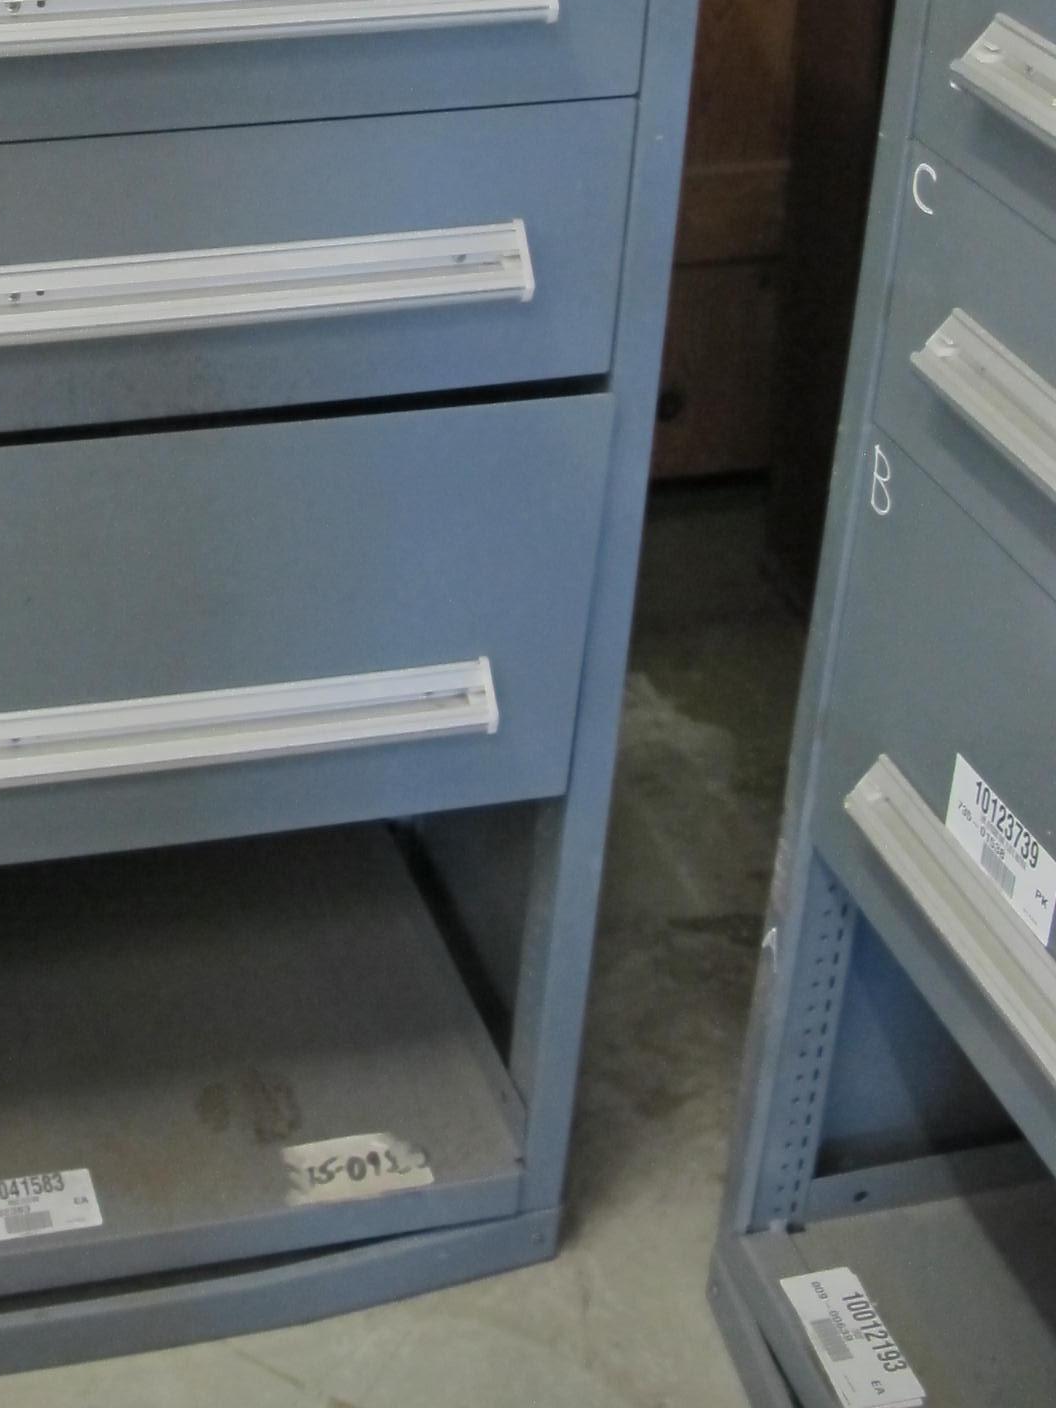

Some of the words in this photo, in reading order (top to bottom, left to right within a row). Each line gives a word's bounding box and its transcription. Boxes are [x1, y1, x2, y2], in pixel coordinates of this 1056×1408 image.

[912, 163, 936, 214] C
[870, 445, 891, 516] B
[975, 780, 1040, 869] 10123739
[1034, 888, 1049, 910] PK
[841, 1290, 908, 1373] 10012193
[870, 1379, 886, 1396] EA
